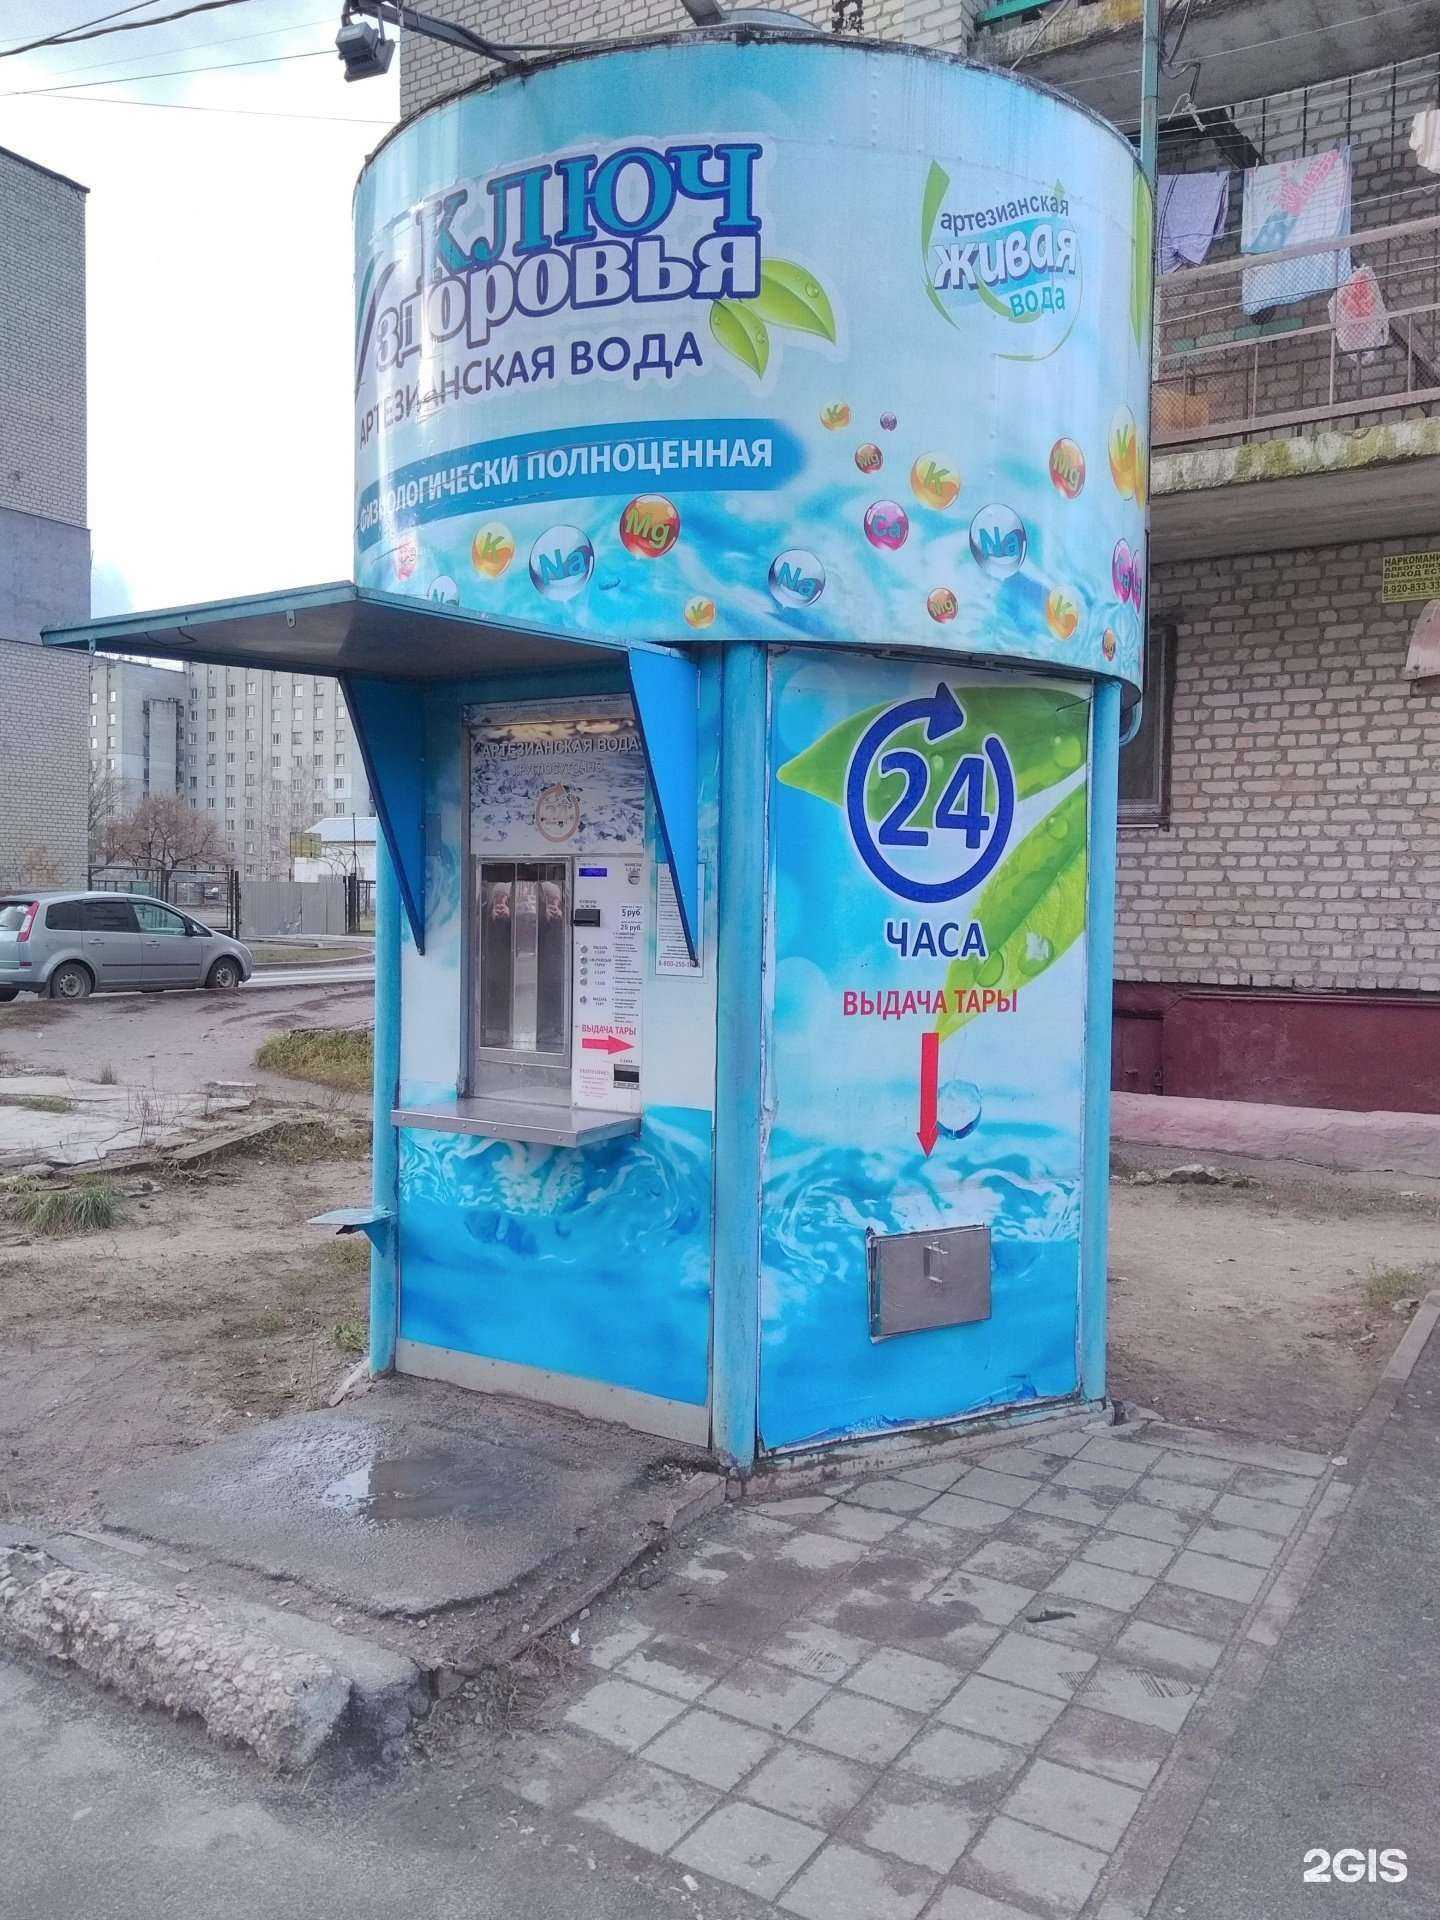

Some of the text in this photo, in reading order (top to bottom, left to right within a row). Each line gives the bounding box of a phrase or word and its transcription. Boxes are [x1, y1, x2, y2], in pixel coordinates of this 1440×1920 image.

[416, 142, 763, 285] КЛЮЧ
[940, 195, 1069, 237] артезианская
[933, 224, 1077, 291] живая
[1009, 286, 1066, 318] вода
[570, 331, 704, 381] ВОДА
[527, 438, 773, 481] ПОЛНОЦЕННАЯ
[625, 508, 671, 549] Mg
[978, 526, 1023, 561] Na
[538, 545, 592, 585] Na
[776, 561, 818, 598] Na
[597, 736, 642, 753] ВОДА
[877, 750, 991, 850] 24
[886, 921, 987, 958] ЧАСА
[843, 989, 1018, 1020] ВЫДАЧА ТАРЫ
[581, 1024, 637, 1036] ВЫДАЧА ТАРЫ
